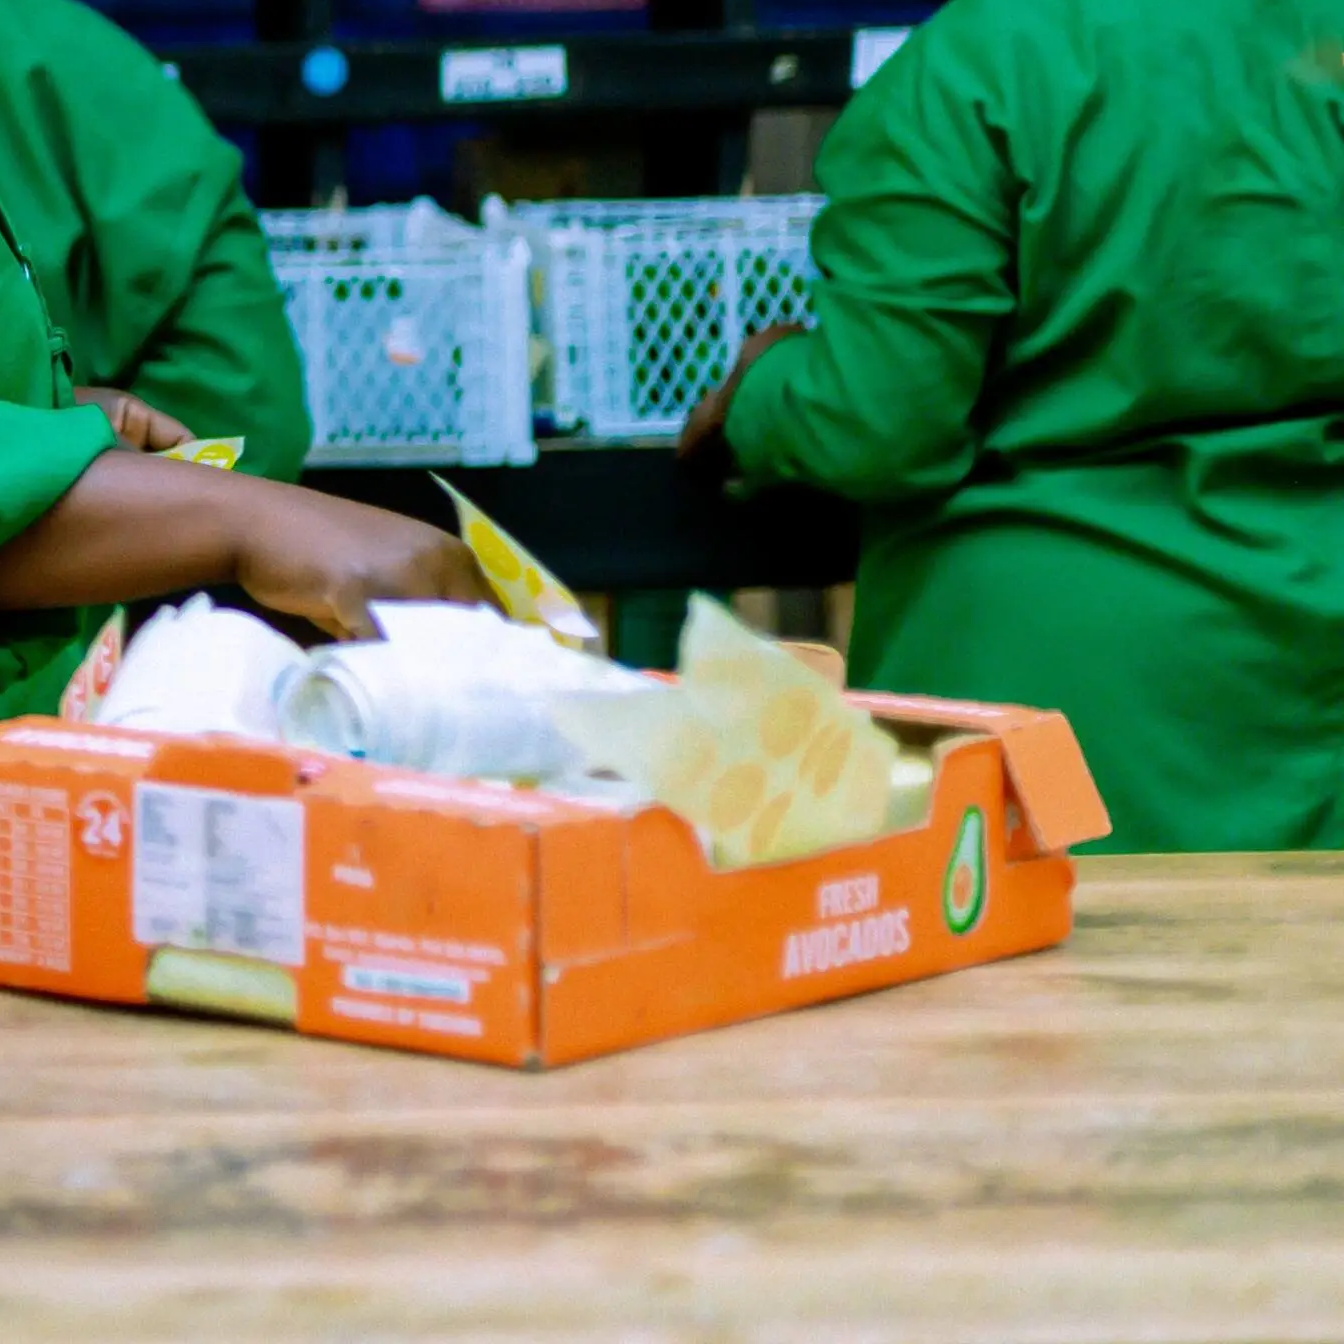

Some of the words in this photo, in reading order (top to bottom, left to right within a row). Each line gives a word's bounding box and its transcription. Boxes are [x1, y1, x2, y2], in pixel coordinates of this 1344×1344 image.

[81, 806, 123, 847] 24
[819, 872, 880, 919] FRESH
[783, 908, 911, 979] AVOCADOS
